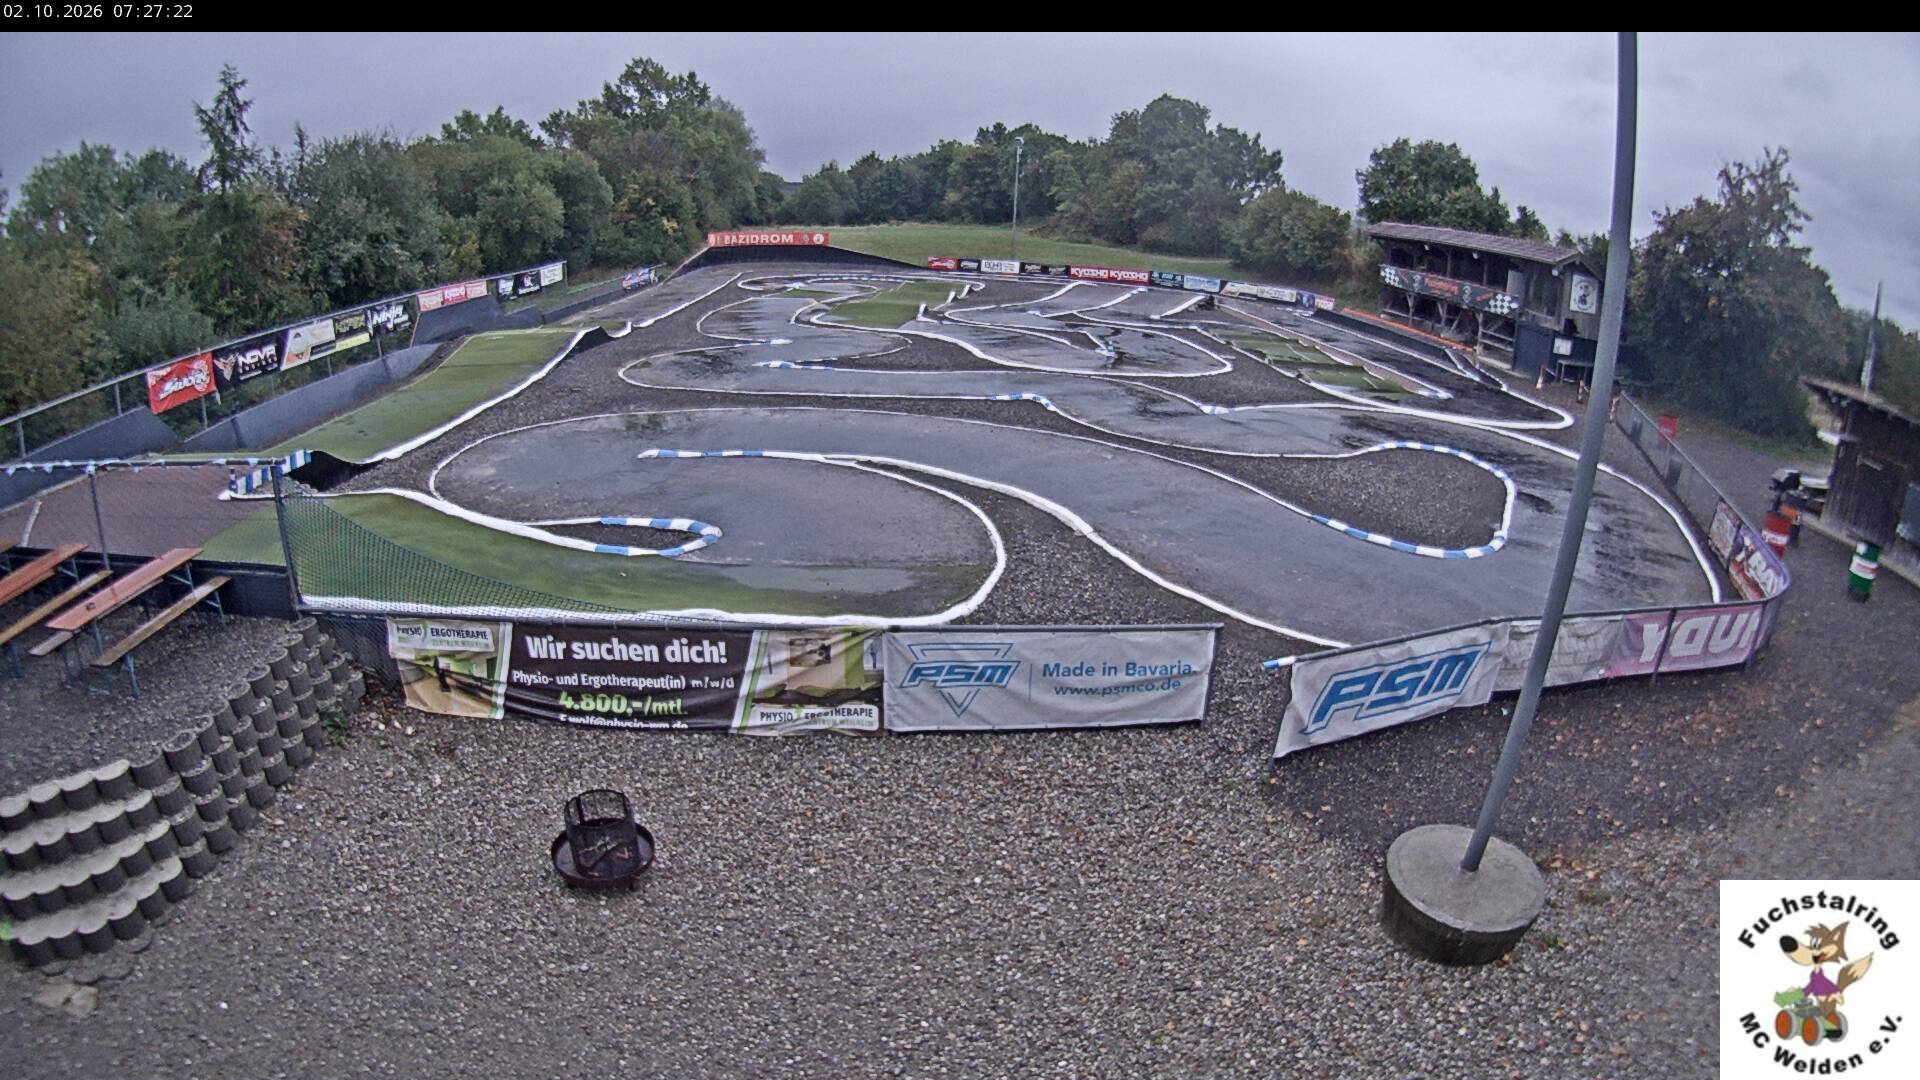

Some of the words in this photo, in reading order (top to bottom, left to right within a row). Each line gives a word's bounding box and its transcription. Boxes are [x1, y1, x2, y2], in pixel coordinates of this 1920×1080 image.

[724, 233, 794, 245] BAZIDROM
[430, 627, 488, 640] ERGOTHERAPIE
[525, 635, 566, 659] Wir
[571, 636, 660, 663] suchen
[664, 637, 728, 664] dich!
[902, 661, 1018, 686] PSM
[1042, 661, 1095, 678] Made
[1102, 662, 1117, 677] in
[511, 669, 554, 686] Physio-
[556, 673, 579, 686] und
[581, 673, 686, 691] Ergotherapeut(in)
[691, 676, 735, 689] m/w/d
[1054, 678, 1181, 697] www.psmco.de
[1307, 646, 1486, 730] PSM
[760, 711, 793, 722] PHYSIO
